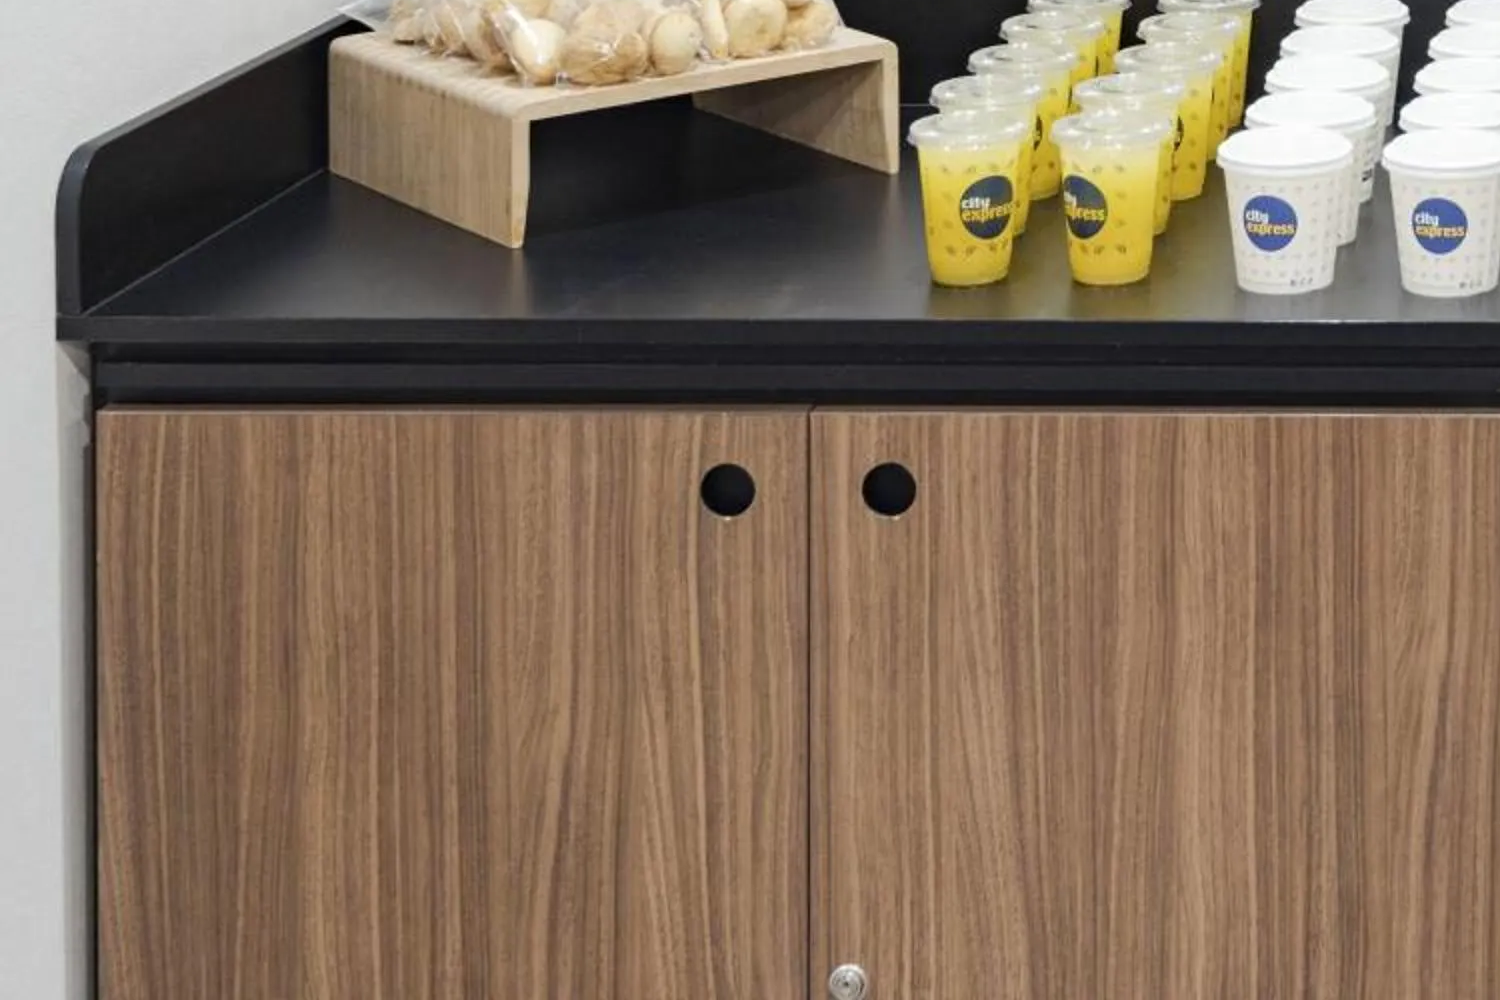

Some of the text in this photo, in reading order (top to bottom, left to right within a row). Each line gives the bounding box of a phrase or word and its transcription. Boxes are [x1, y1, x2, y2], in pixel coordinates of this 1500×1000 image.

[961, 198, 991, 211] city
[1246, 210, 1269, 222] city
[1415, 212, 1439, 226] city
[1247, 222, 1295, 236] express
[1416, 226, 1465, 239] express
